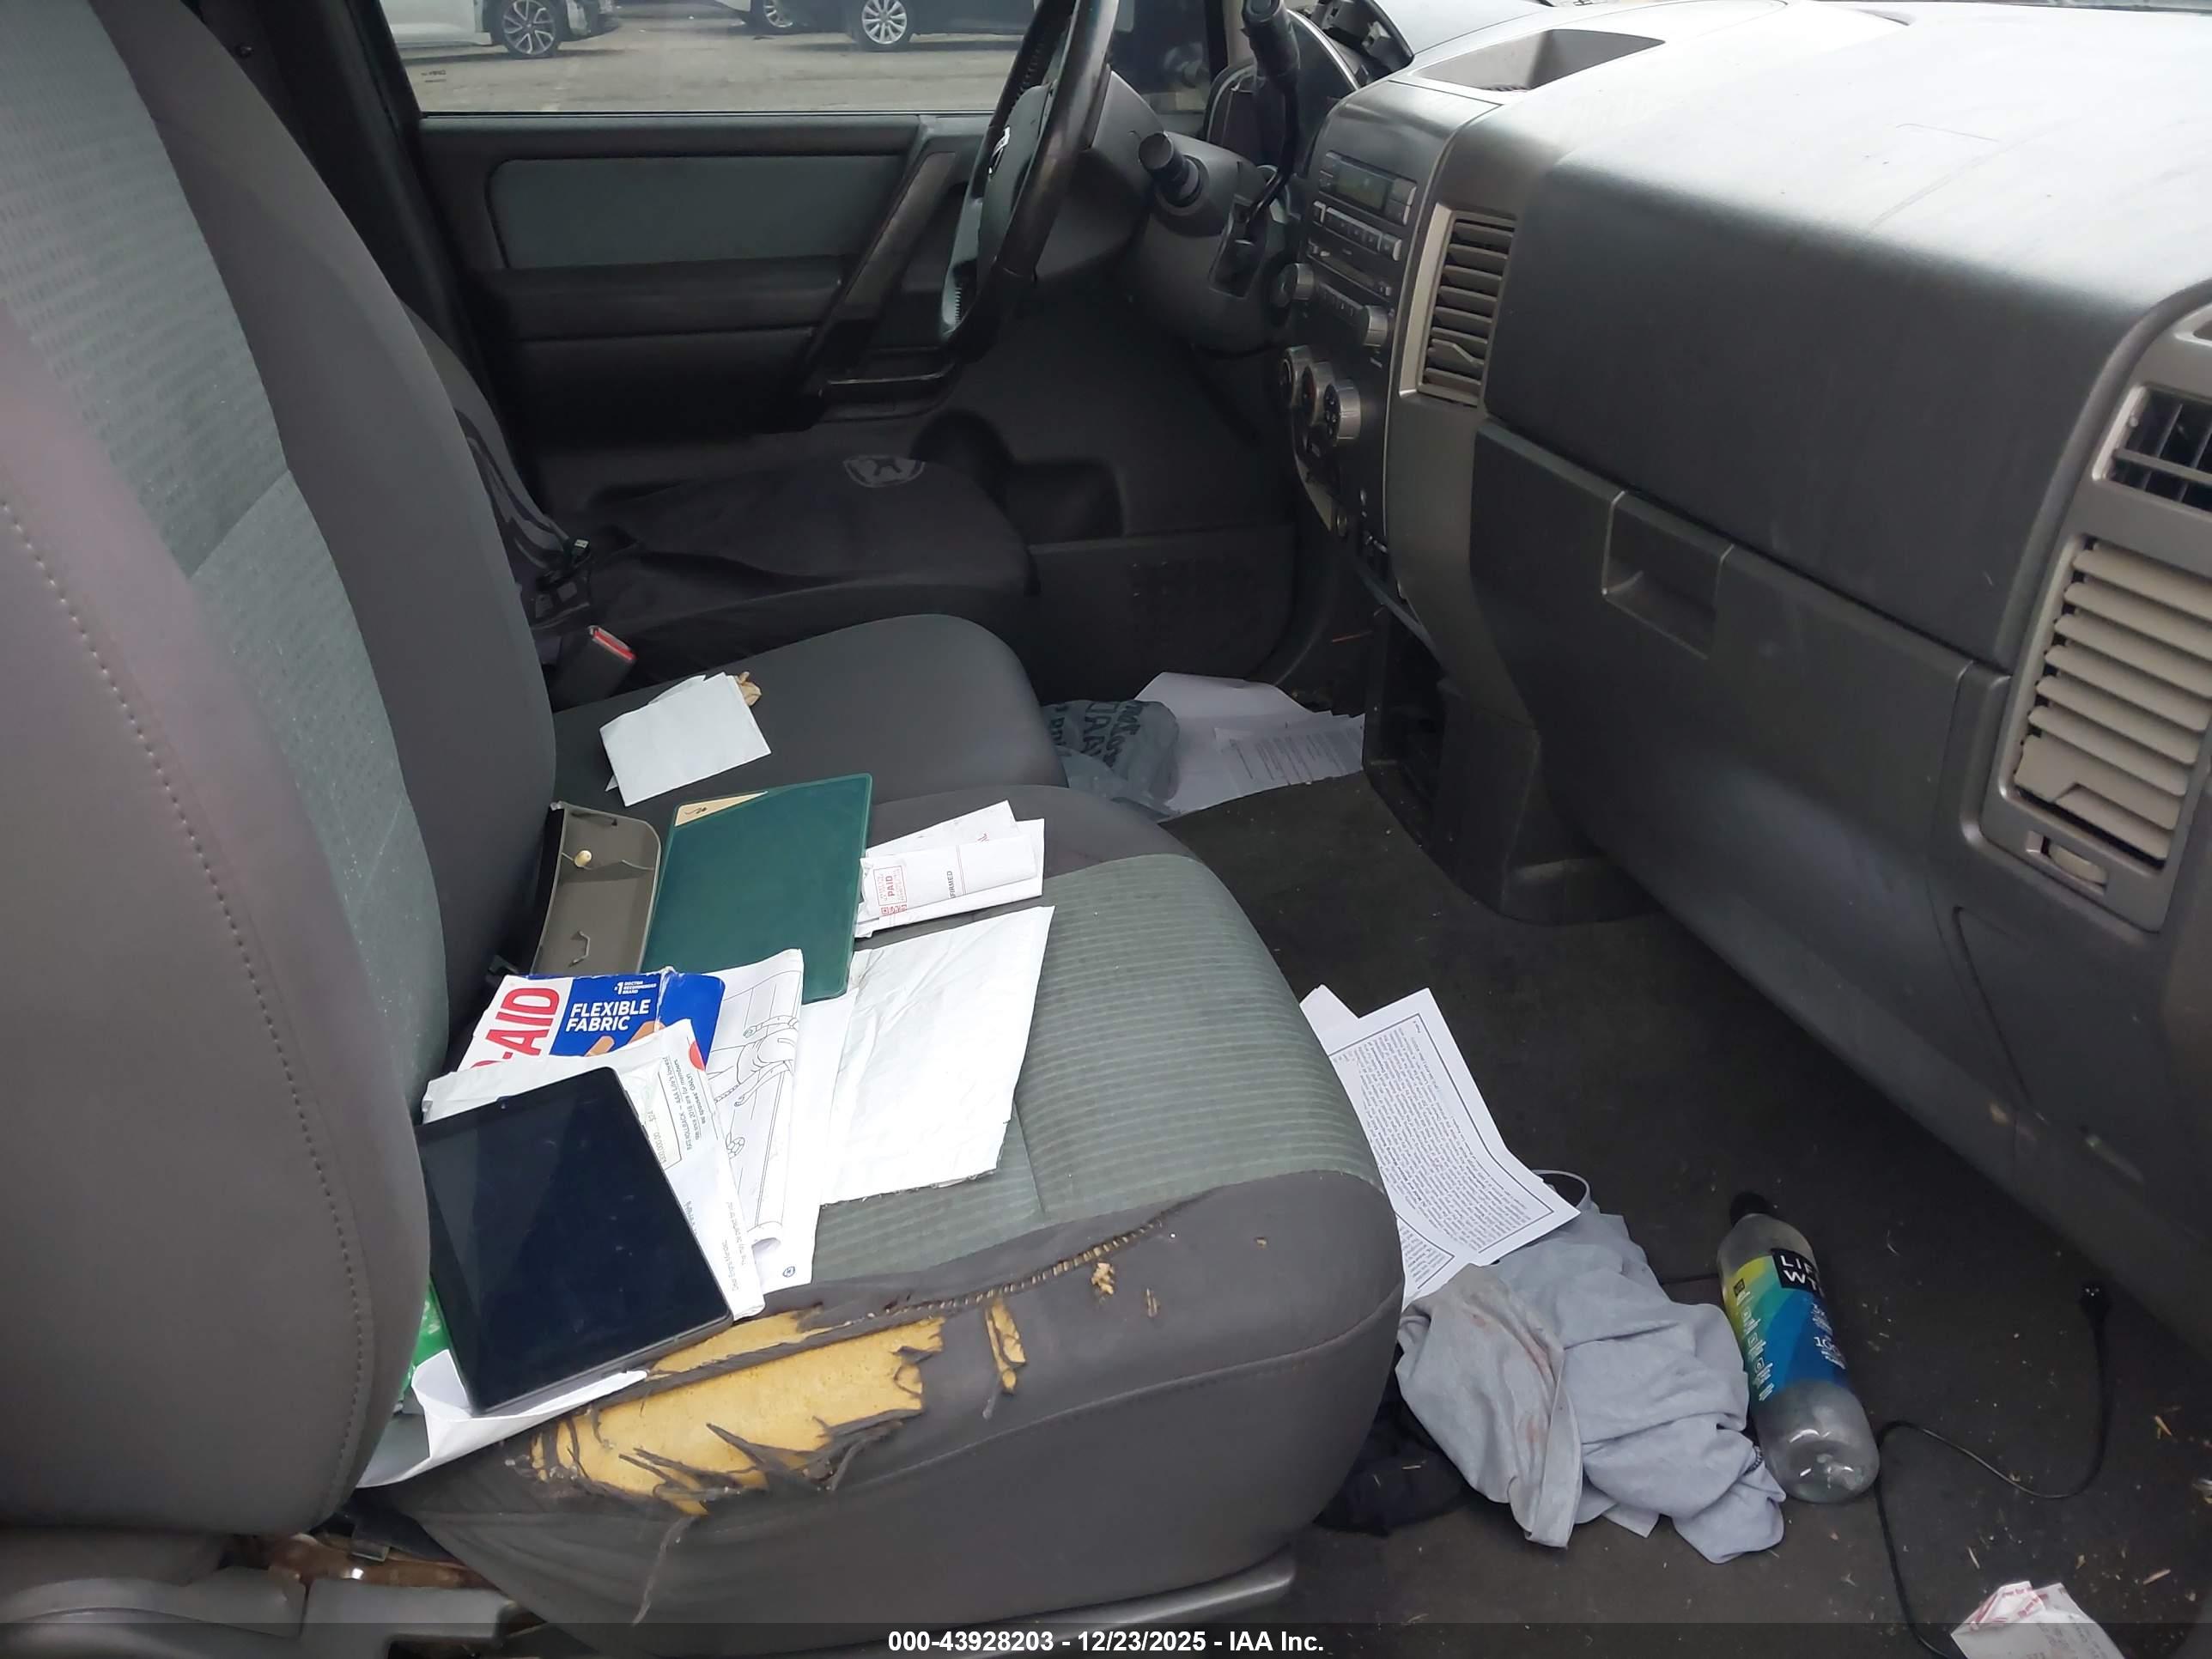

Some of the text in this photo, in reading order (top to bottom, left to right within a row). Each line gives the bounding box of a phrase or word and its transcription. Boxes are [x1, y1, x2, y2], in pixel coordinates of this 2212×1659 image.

[885, 876, 895, 897] PAID
[946, 870, 956, 898] FIRMED
[570, 999, 652, 1018] FLEXIBLE
[471, 988, 560, 1068] -AID
[565, 1016, 631, 1032] FABRIC
